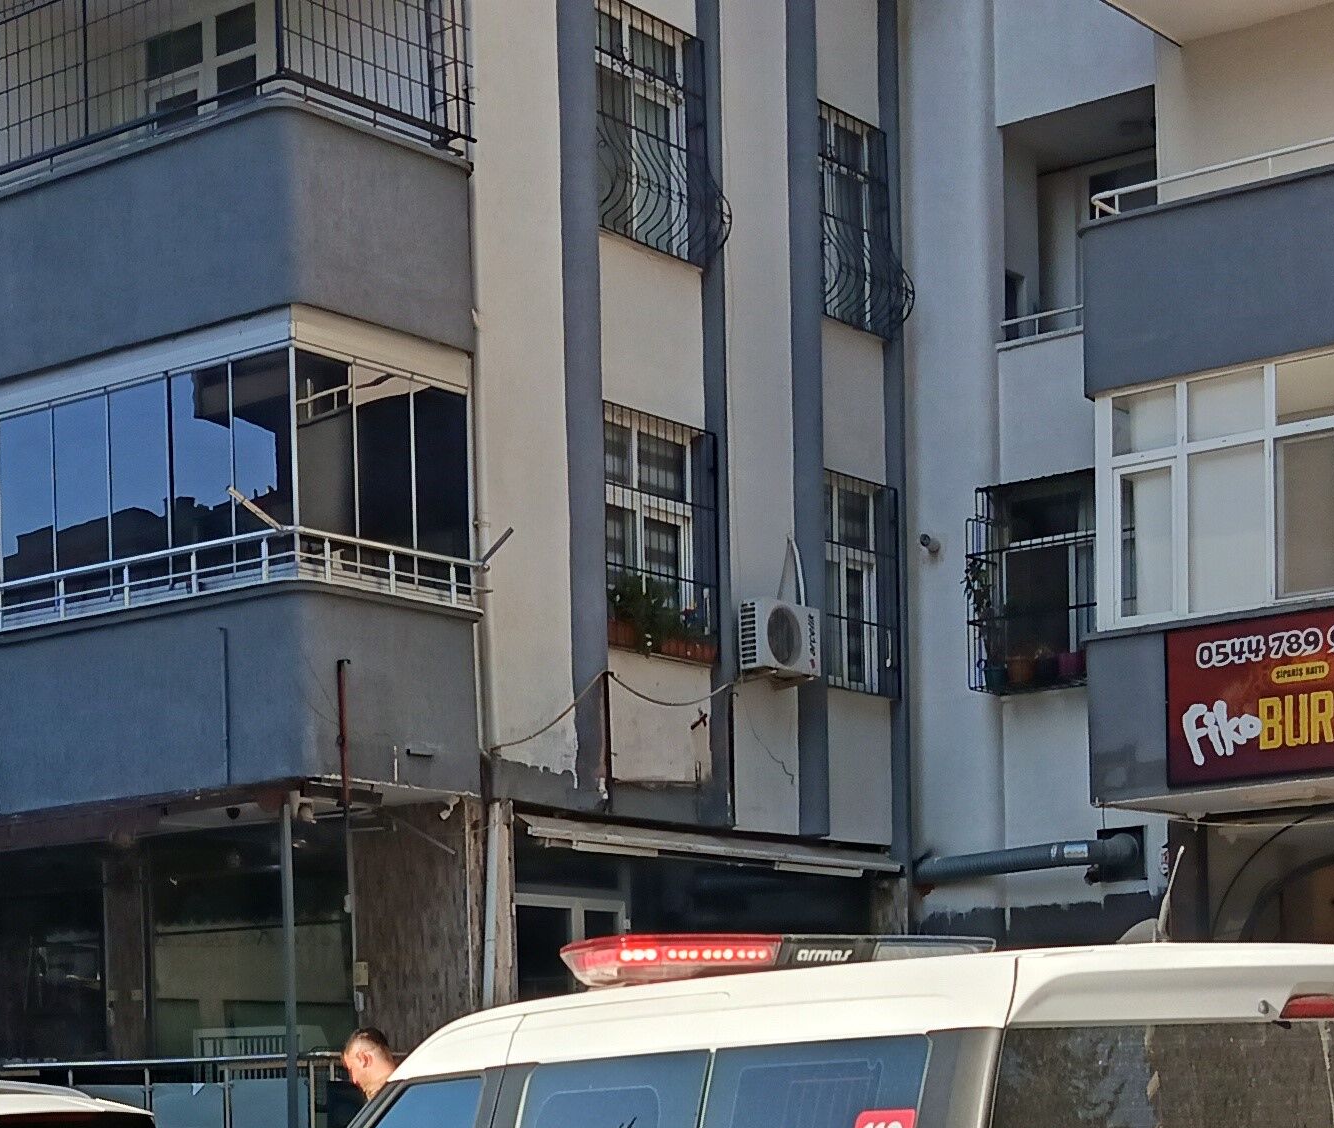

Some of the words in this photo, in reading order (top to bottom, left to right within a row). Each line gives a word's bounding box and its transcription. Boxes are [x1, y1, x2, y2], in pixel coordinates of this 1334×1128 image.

[1196, 635, 1265, 668] 0544
[1269, 627, 1323, 659] 789
[796, 948, 853, 962] armas
